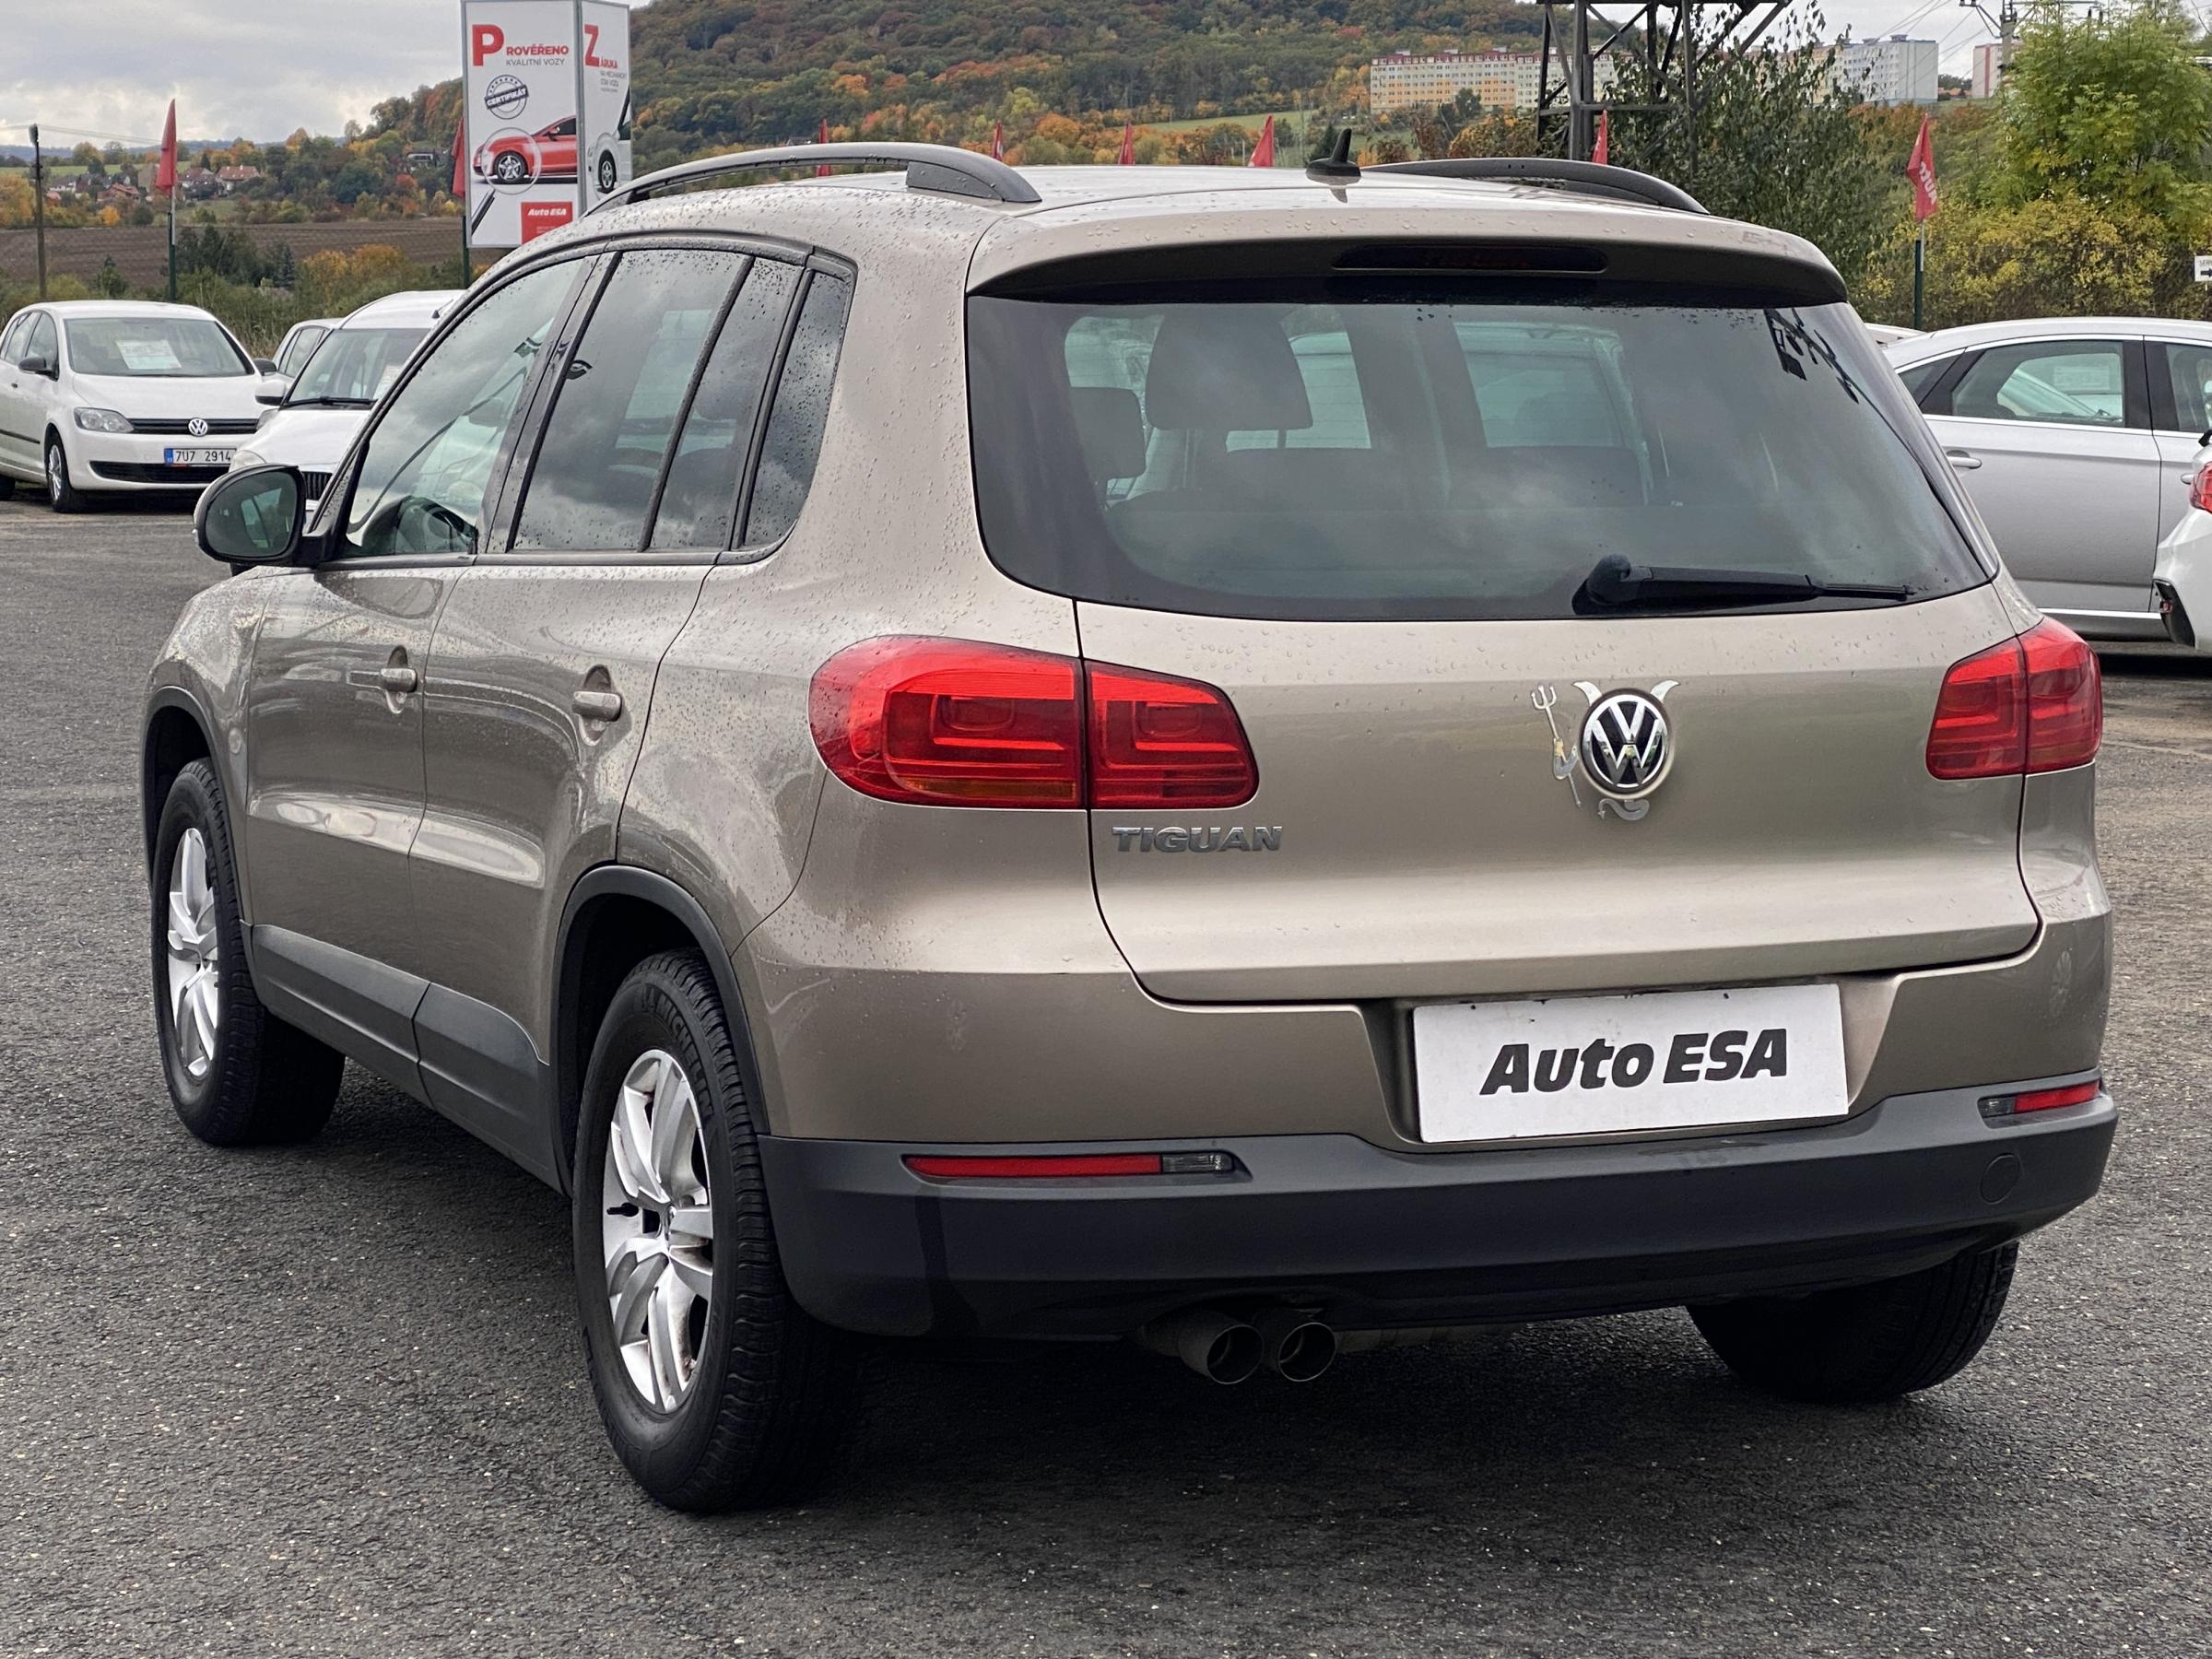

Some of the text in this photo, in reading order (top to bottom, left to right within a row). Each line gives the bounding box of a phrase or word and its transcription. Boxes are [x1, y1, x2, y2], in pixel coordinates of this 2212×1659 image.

[506, 58, 542, 66] KVALITNÍ
[175, 451, 231, 462] 7U7 2914
[1112, 826, 1283, 853] TIGUAN
[1479, 1028, 1787, 1096] Auto ESA
